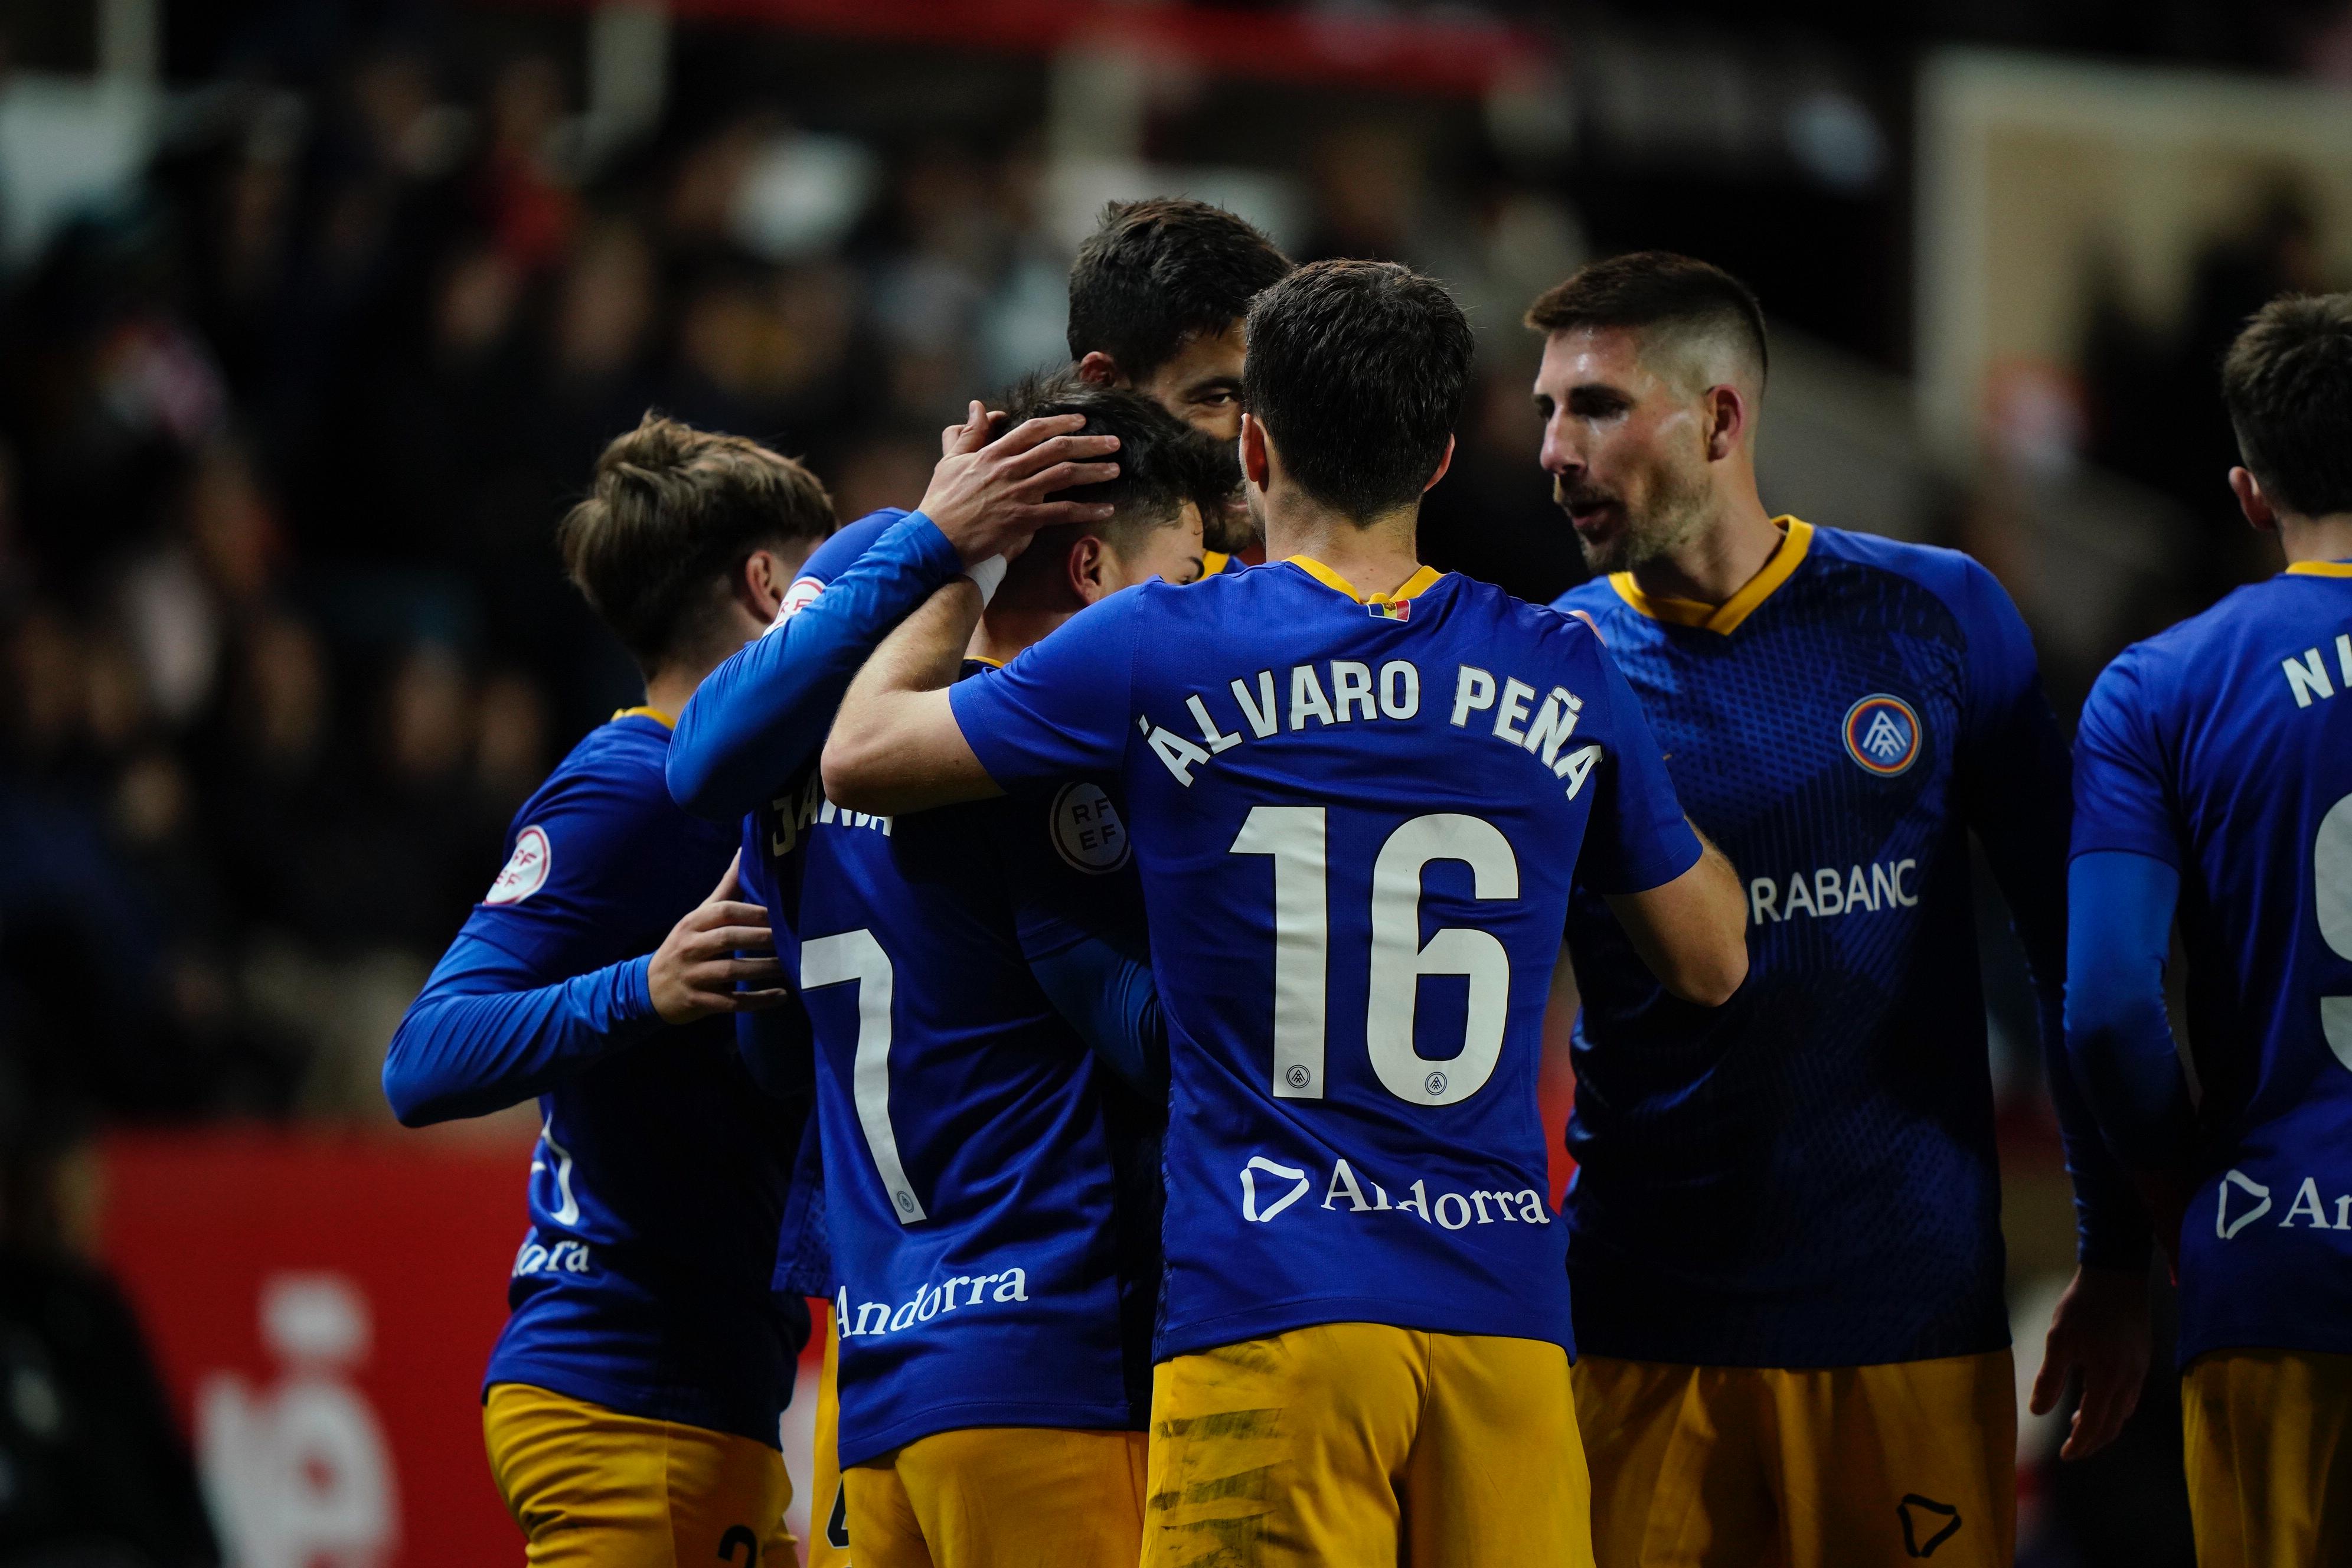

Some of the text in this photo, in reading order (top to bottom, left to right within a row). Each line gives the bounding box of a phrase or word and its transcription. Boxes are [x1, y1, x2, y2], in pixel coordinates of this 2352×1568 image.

[1137, 659, 1603, 801] ÁLVARO PEÑA
[1072, 798, 1109, 825] RF
[1079, 824, 1116, 851] EF
[1229, 806, 1519, 1106] 16
[799, 928, 927, 1225] 7
[836, 1267, 1029, 1341] Andorra
